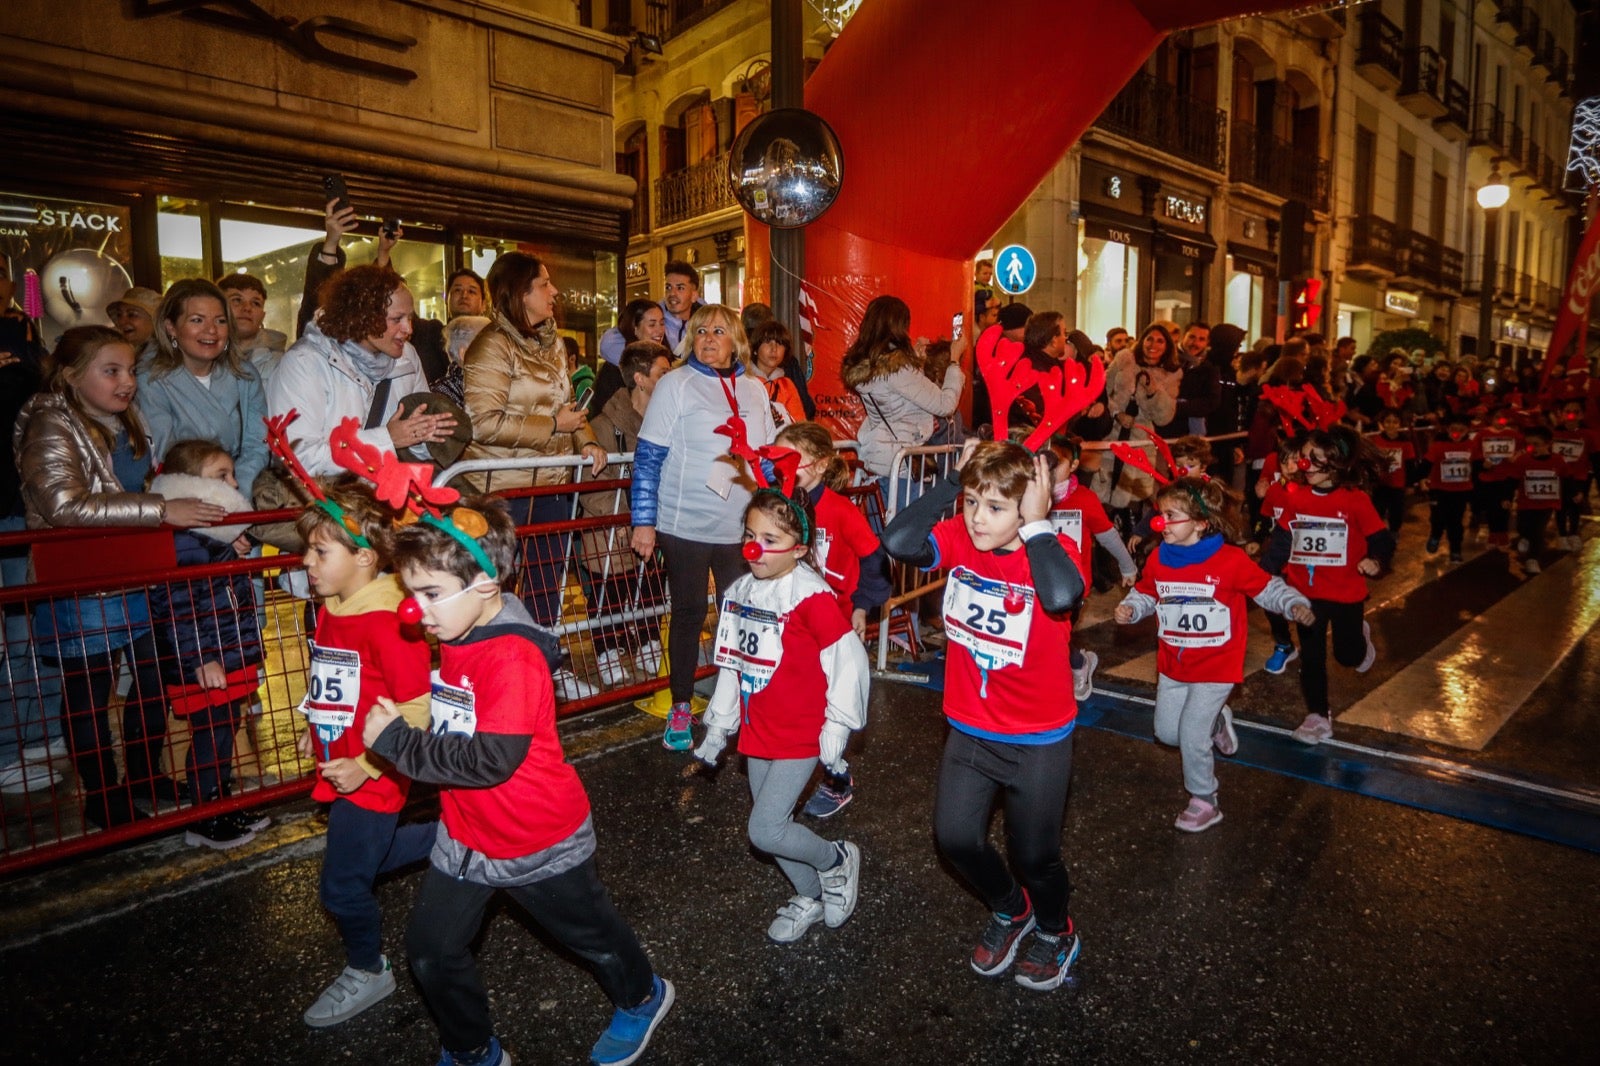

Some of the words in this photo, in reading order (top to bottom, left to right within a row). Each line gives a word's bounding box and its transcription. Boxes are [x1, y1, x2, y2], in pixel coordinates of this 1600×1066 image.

[1166, 196, 1204, 224] TOUS
[41, 209, 120, 232] STACK
[1109, 229, 1130, 243] TOUS
[1182, 244, 1199, 258] TOUS
[1531, 484, 1552, 492] 121
[1302, 536, 1328, 552] 38
[966, 603, 1008, 635] 25
[1177, 613, 1208, 631] 40
[738, 629, 760, 655] 28
[310, 674, 344, 702] 05
